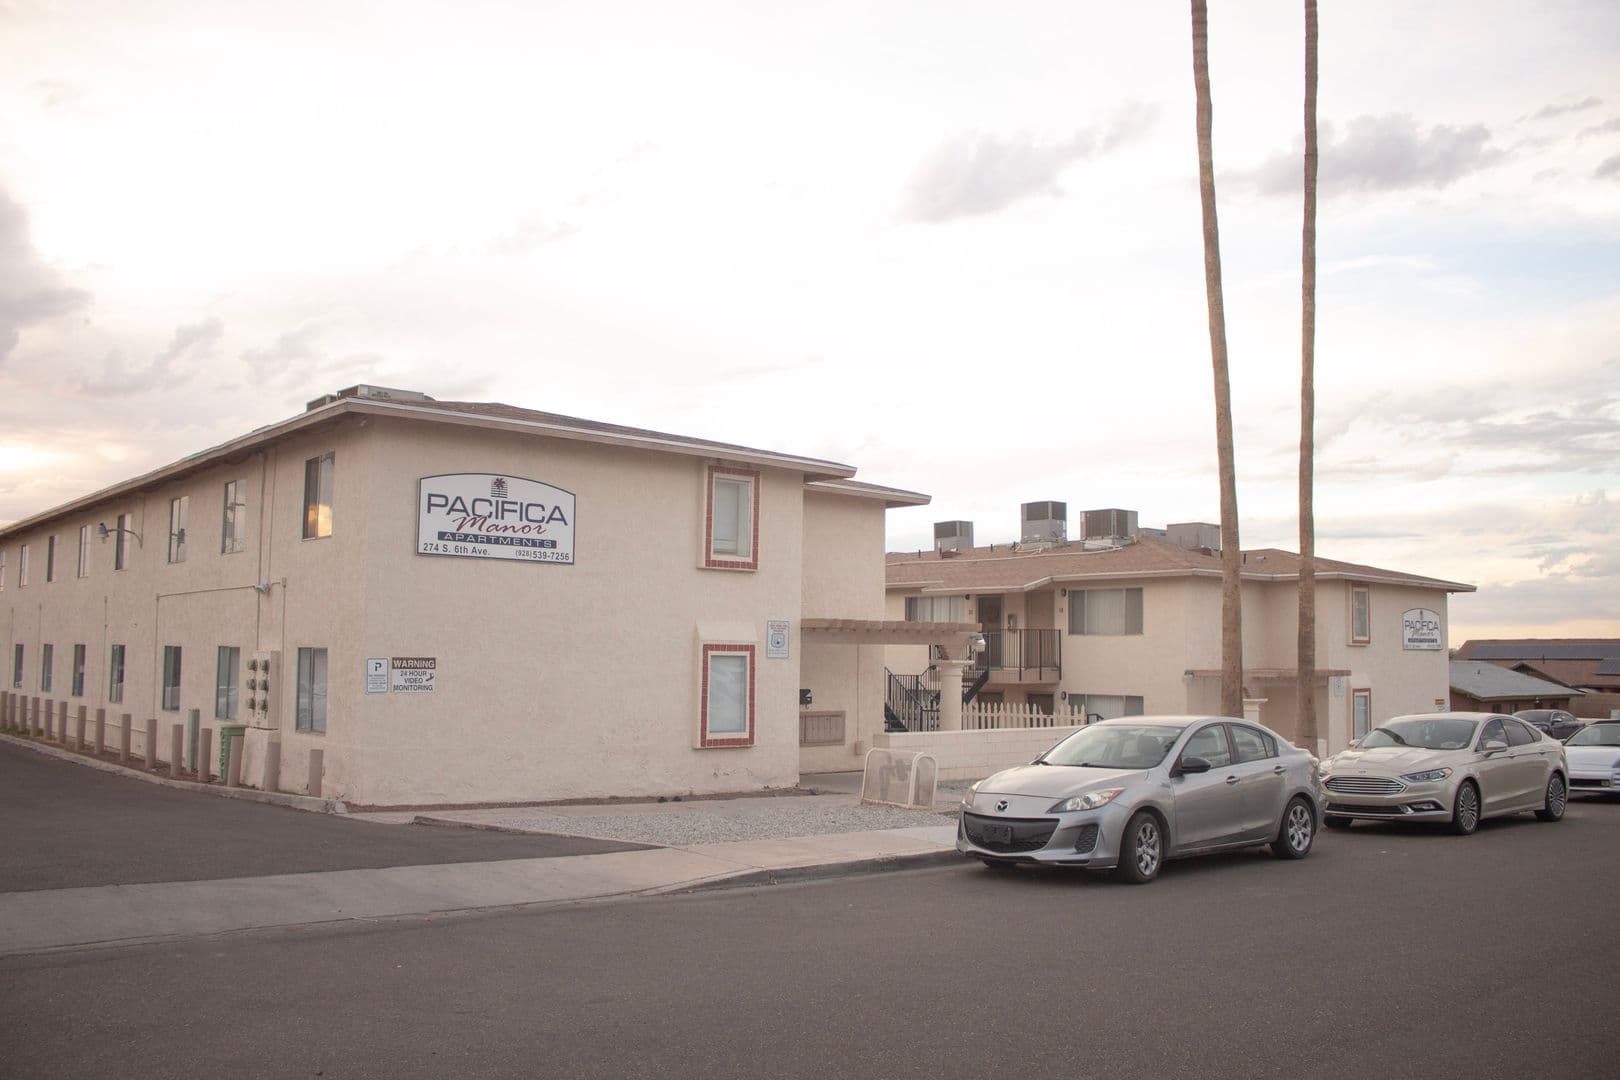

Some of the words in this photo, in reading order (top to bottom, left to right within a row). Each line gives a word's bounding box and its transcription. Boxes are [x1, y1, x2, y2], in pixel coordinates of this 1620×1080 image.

[427, 493, 568, 526] PACIFICA
[452, 515, 547, 535] Manor
[443, 533, 552, 548] APARTMENTS
[423, 543, 439, 552] 274
[442, 544, 451, 553] S.
[454, 545, 469, 554] 6th
[471, 546, 490, 556] Ave.
[393, 660, 435, 668] WARNING
